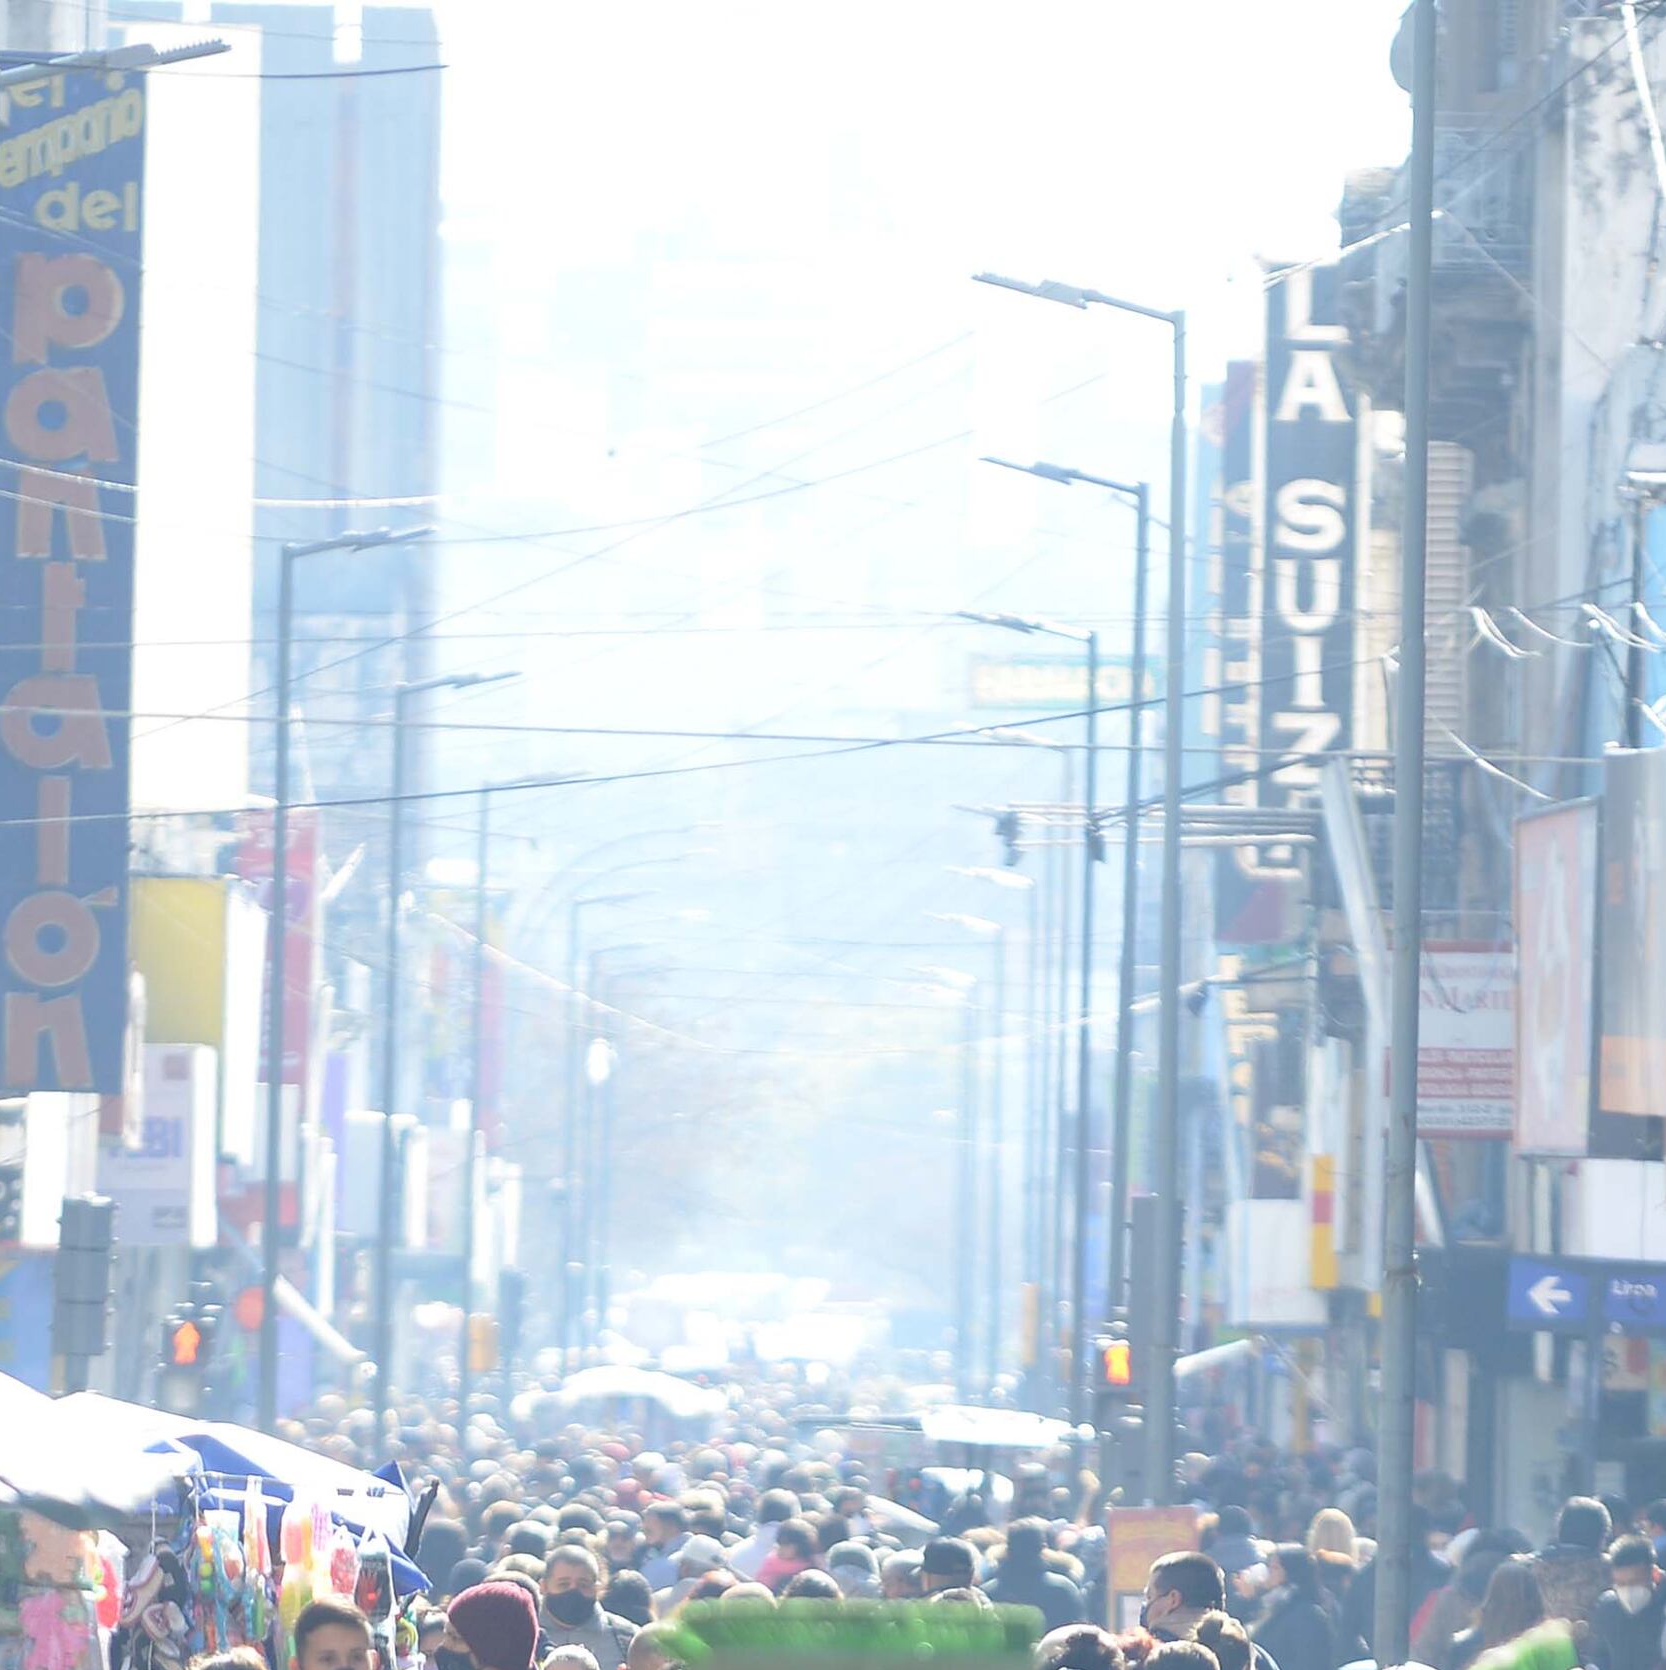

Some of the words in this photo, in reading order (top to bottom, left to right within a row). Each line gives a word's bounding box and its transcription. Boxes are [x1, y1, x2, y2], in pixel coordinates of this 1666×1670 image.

[35, 181, 140, 232] del
[1276, 266, 1352, 422] LA
[1269, 476, 1349, 808] SUIZ
